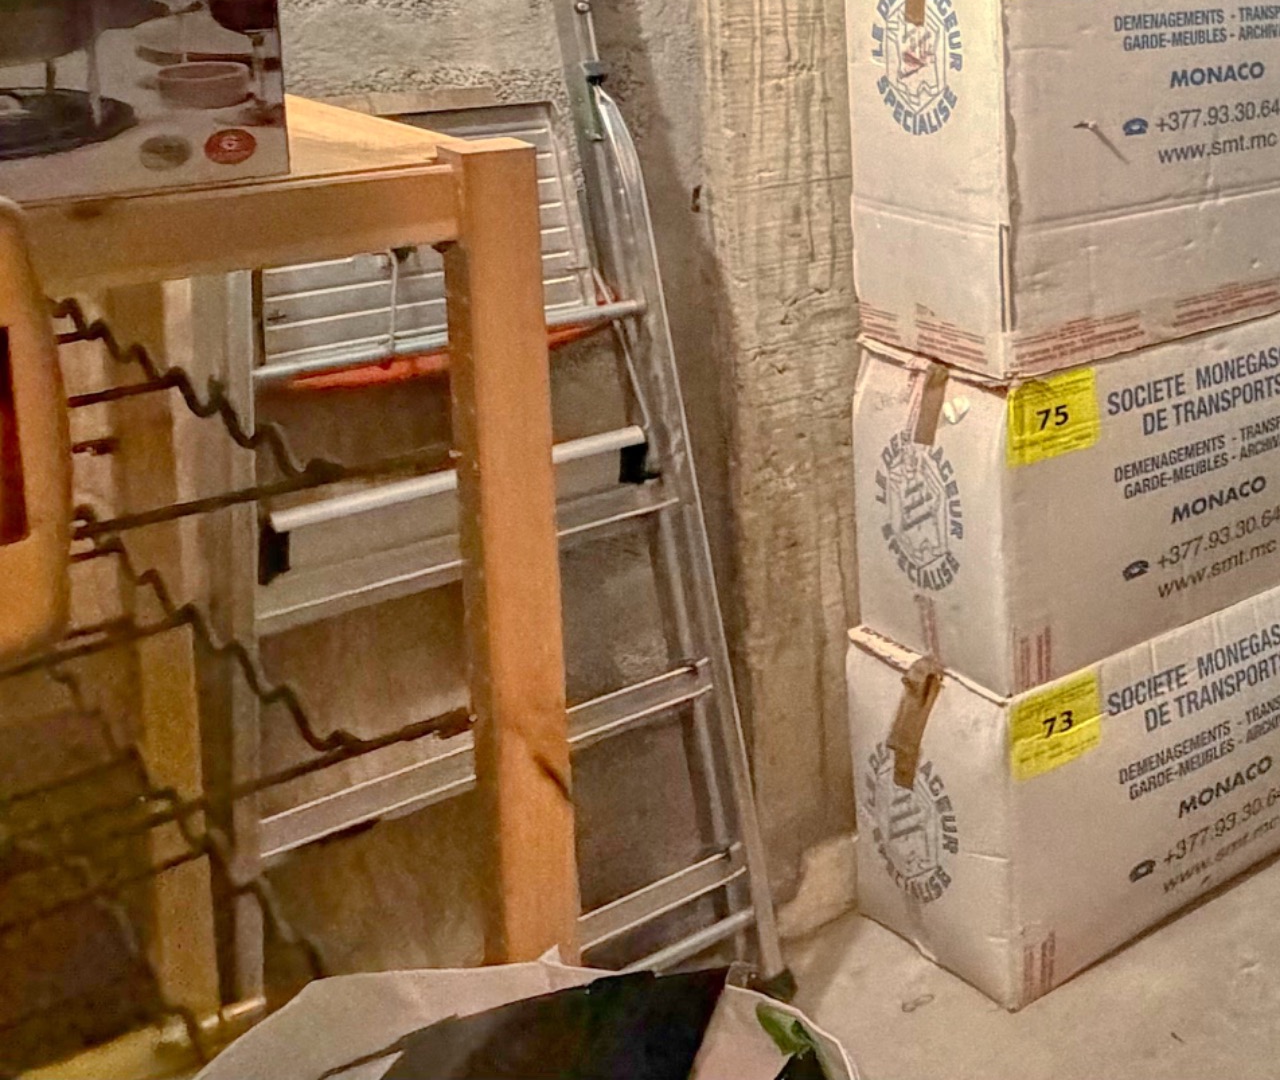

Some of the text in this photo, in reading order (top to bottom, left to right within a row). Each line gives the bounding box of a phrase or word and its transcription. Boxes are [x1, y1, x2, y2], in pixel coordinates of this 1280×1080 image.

[871, 23, 885, 57] LE
[1114, 8, 1224, 32] DEMENAGEMENTS
[1123, 30, 1228, 51] GARDE-MEUBLES
[1170, 61, 1265, 89] MONACO
[877, 75, 958, 136] SPECIALISE
[1158, 132, 1278, 164] www.smt.mc
[1107, 373, 1186, 416] SOCIETE
[1036, 404, 1069, 431] 75
[1142, 408, 1168, 436] DE
[1114, 434, 1226, 483] DEMENAGEMENTS
[1124, 452, 1229, 499] GARDE-MEUBLES
[1171, 475, 1267, 525] MONACO
[1158, 539, 1277, 599] www.smt.mc
[1107, 663, 1188, 717] SOCIETE
[1042, 709, 1073, 738] 73
[1144, 702, 1172, 733] DE
[1118, 720, 1231, 785] DEMENAGEMENTS
[1129, 737, 1235, 800] GARDE-MEUBLES
[1178, 755, 1273, 818] MONACO
